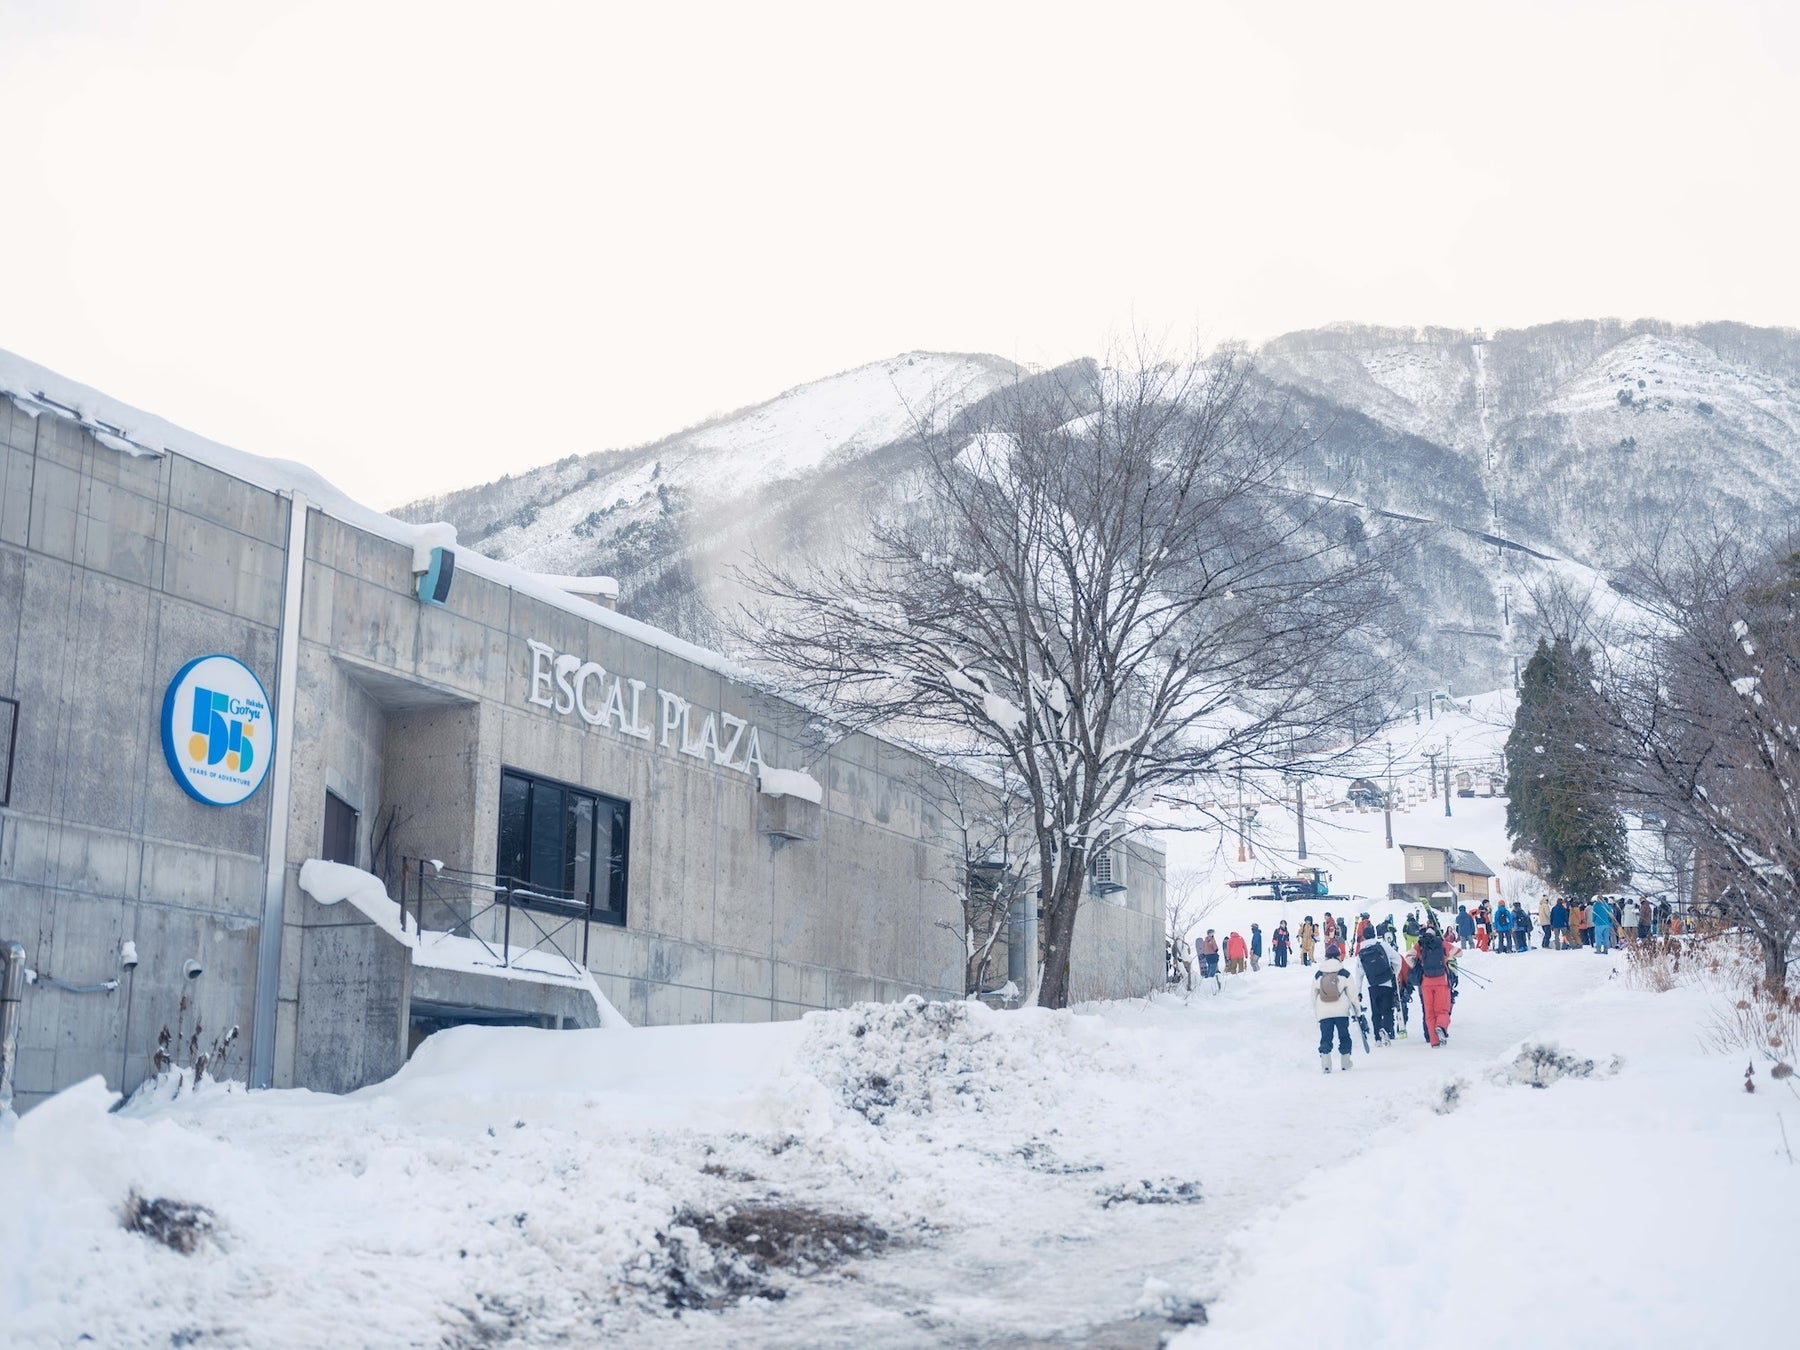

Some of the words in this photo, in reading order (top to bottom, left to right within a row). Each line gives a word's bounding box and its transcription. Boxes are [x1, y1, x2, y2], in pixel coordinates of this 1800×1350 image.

[230, 698, 260, 722] Goryu
[527, 638, 651, 741] ESCAL
[657, 688, 763, 774] PLAZA
[189, 767, 206, 776] YEARS
[209, 771, 217, 779] OF
[218, 774, 251, 786] ADVENTURE
